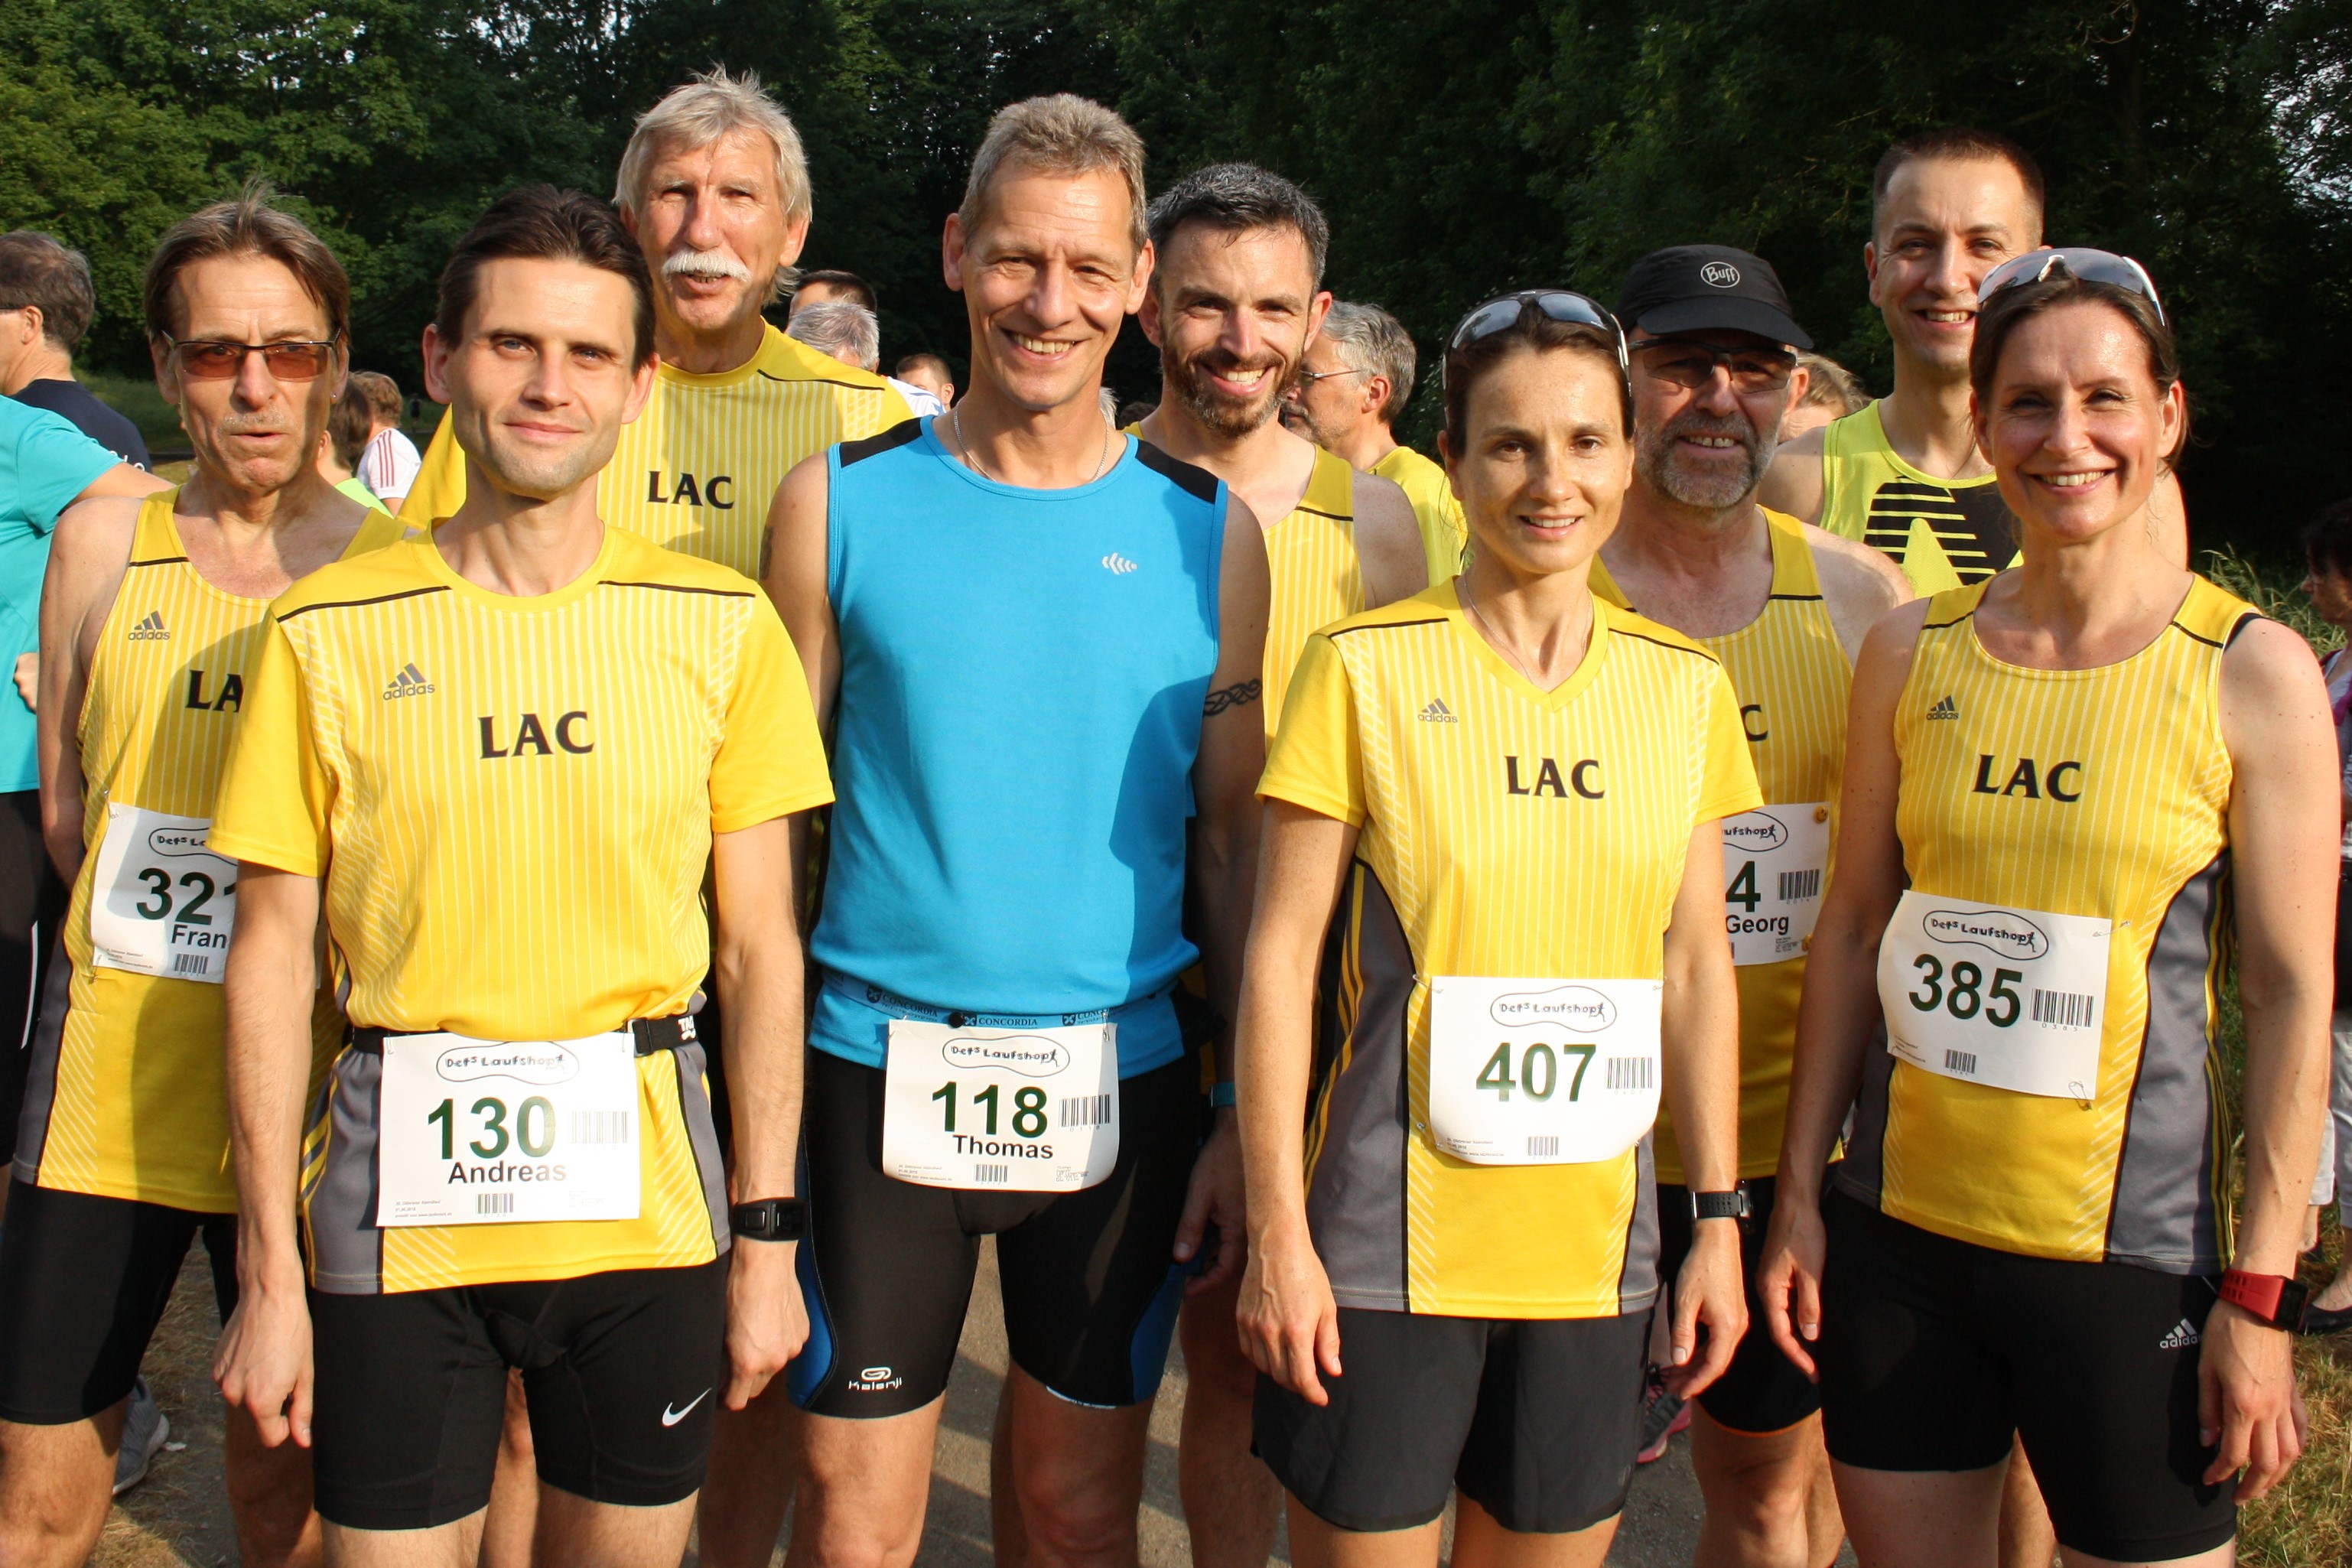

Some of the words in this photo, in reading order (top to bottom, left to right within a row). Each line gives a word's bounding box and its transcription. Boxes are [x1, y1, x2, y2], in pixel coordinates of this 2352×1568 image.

[1706, 266, 1736, 283] Buff
[646, 470, 735, 510] LAC
[128, 629, 171, 641] adidas
[184, 669, 244, 713] LA
[382, 682, 436, 701] adidas
[1417, 712, 1458, 724] adidas
[1926, 711, 1960, 721] adidas
[477, 711, 595, 760] LAC
[1504, 755, 1605, 800] LAC
[1973, 753, 2082, 802] LAC
[1722, 826, 1768, 837] ufshop
[1725, 860, 1762, 912] 4
[1726, 914, 1790, 935] Georg
[1960, 923, 2027, 943] Laufshop
[171, 923, 228, 950] Fran
[1908, 953, 2023, 1028] 385
[1533, 1003, 1597, 1015] Laufshop
[978, 1017, 1038, 1026] CONCORDIA
[481, 1055, 555, 1069] Laufshop
[983, 1048, 1049, 1062] Laufshop
[1476, 1042, 1597, 1103] 407
[932, 1081, 1048, 1139] 118
[427, 1095, 557, 1160] 130
[952, 1134, 1054, 1160] Thomas
[447, 1160, 568, 1185] Andreas
[2159, 1335, 2201, 1349] adida
